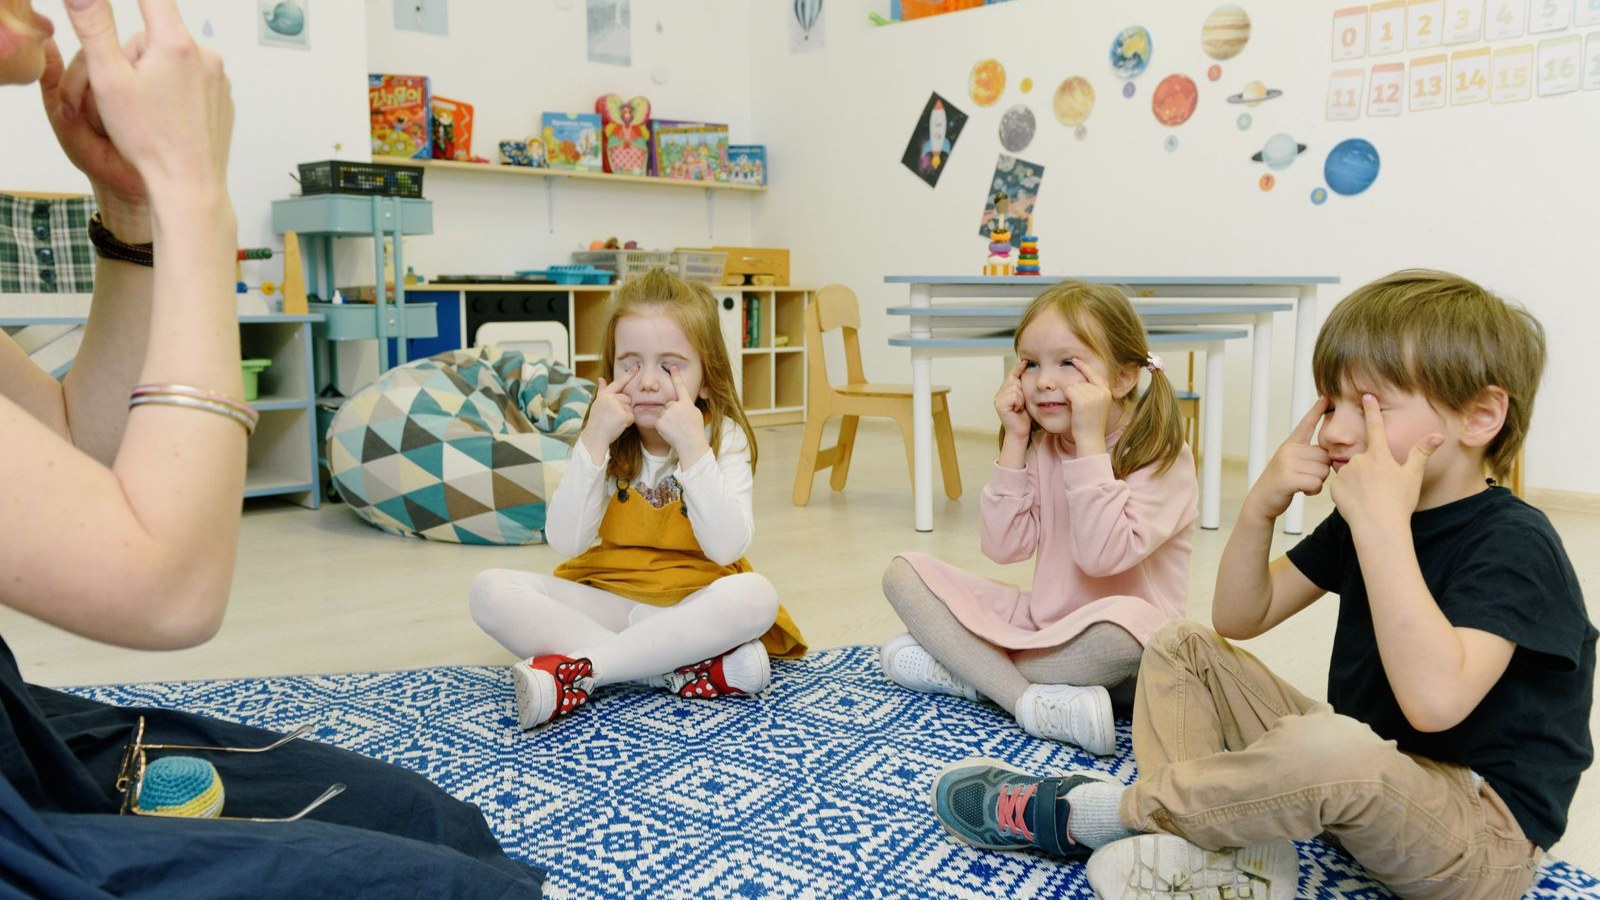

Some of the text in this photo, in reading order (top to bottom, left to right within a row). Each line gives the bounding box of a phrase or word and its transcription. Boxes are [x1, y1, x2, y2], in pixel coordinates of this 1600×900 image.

[1416, 15, 1432, 36] 2
[1453, 8, 1470, 30] 3
[1496, 4, 1514, 26] 4
[1341, 27, 1357, 47] 0
[1380, 22, 1393, 41] 1
[1495, 66, 1527, 90] 15
[1543, 56, 1576, 82] 16
[1414, 76, 1442, 98] 13
[1455, 69, 1486, 92] 14
[1332, 88, 1357, 107] 11
[1373, 83, 1399, 104] 12
